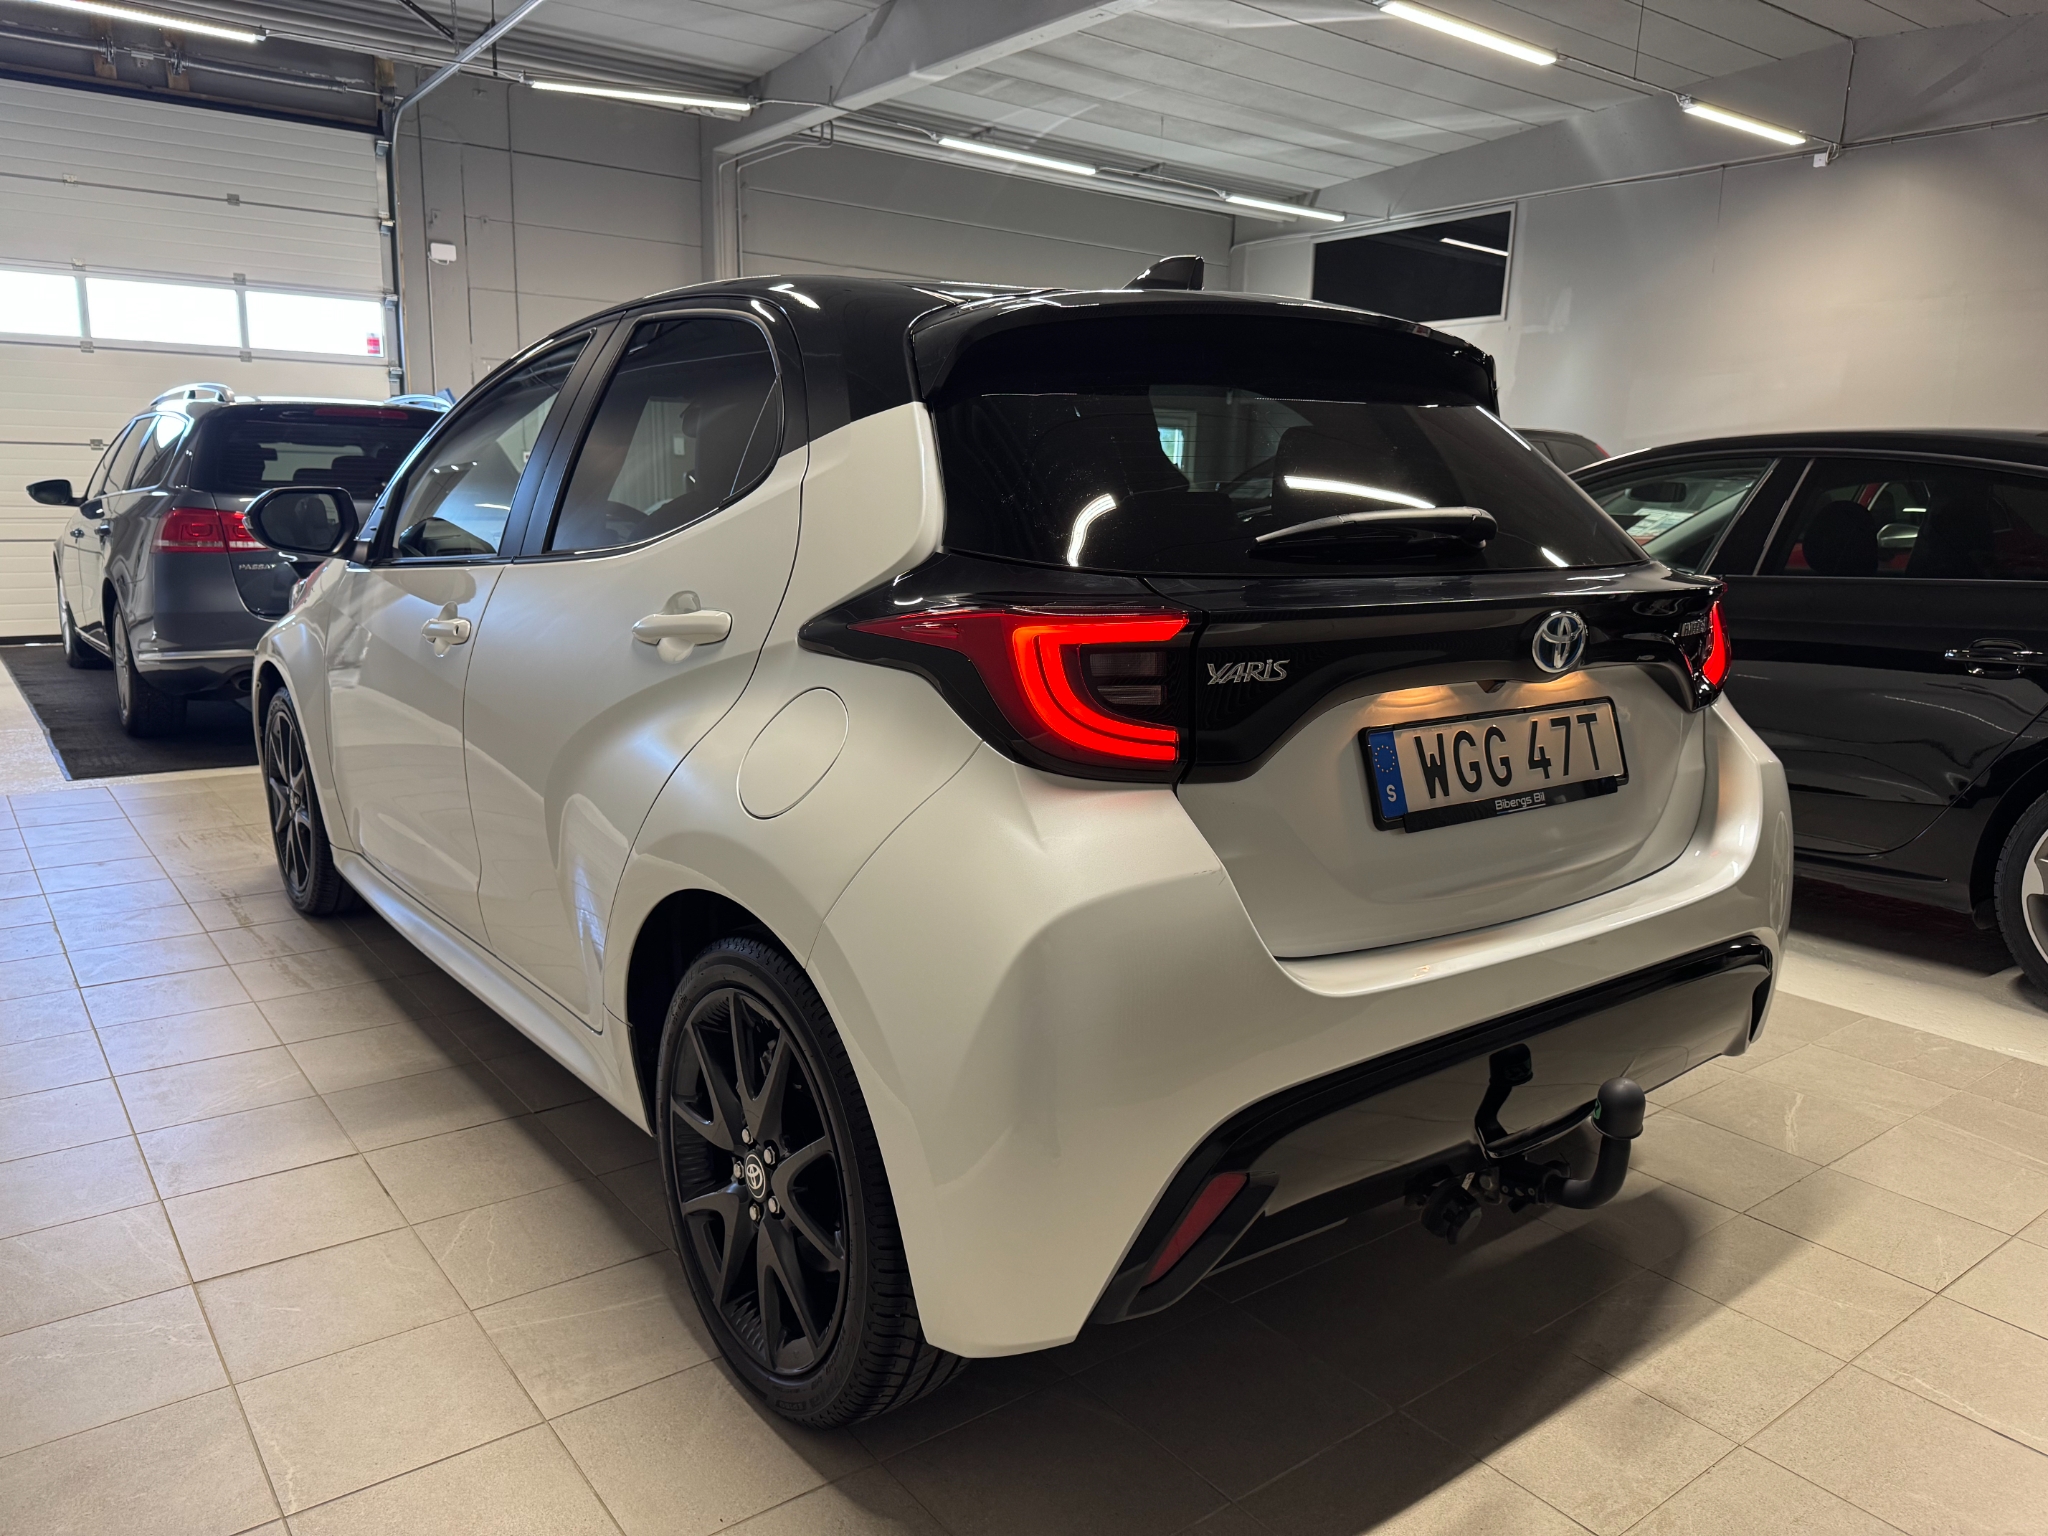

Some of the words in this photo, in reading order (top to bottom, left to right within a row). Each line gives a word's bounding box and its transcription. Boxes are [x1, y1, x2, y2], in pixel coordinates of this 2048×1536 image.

[1414, 727, 1512, 799] WGG
[1528, 713, 1600, 780] 47T
[1386, 784, 1397, 802] S
[1495, 796, 1532, 810] Bibergs
[1533, 792, 1545, 803] Bil
